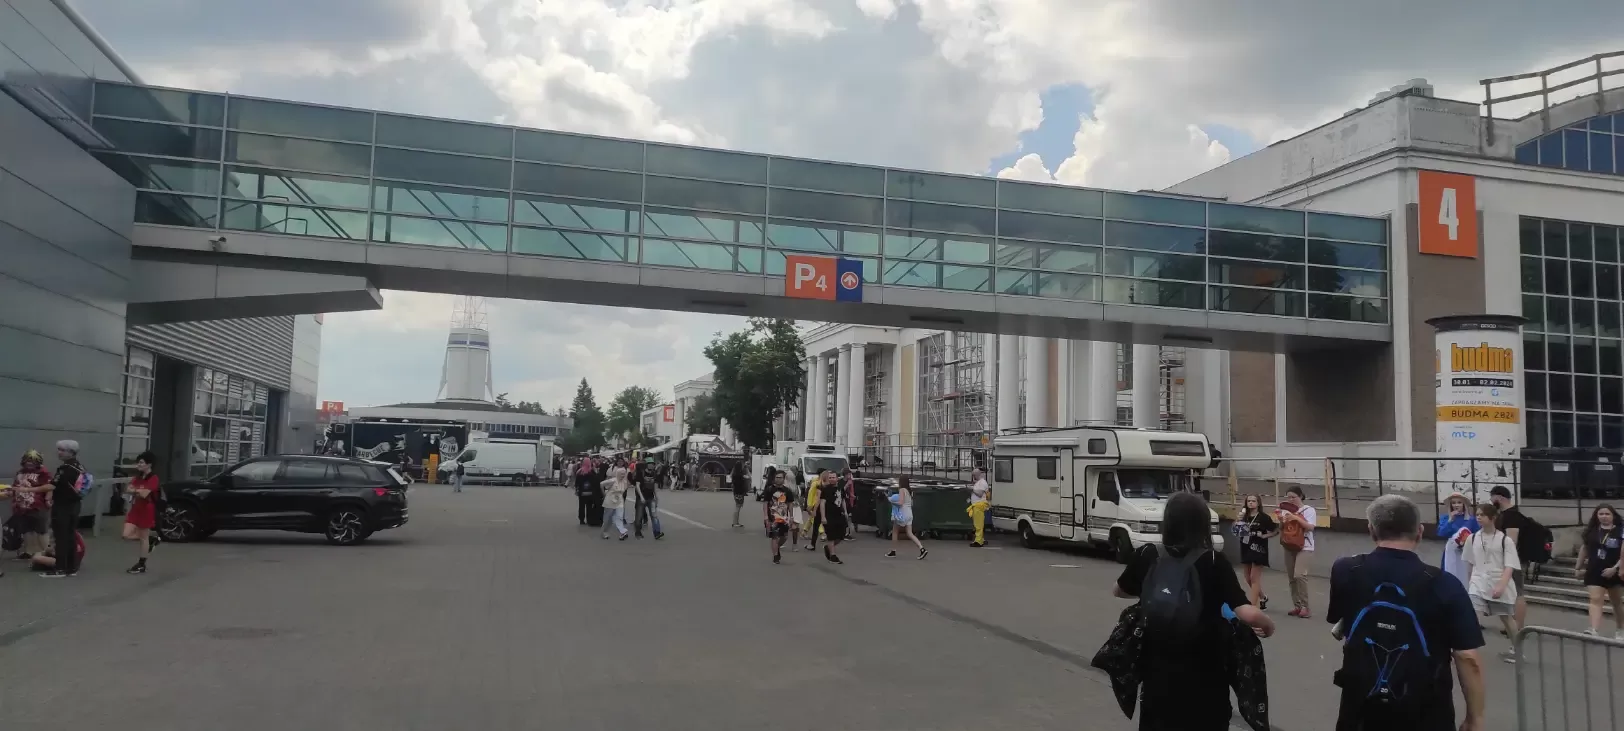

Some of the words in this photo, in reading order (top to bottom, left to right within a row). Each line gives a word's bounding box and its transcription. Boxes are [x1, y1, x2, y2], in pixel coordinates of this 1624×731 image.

[1439, 188, 1459, 240] 4
[795, 263, 827, 292] P4
[1451, 342, 1513, 373] budma
[1452, 410, 1489, 418] BUDMA
[1452, 431, 1476, 439] mtp
